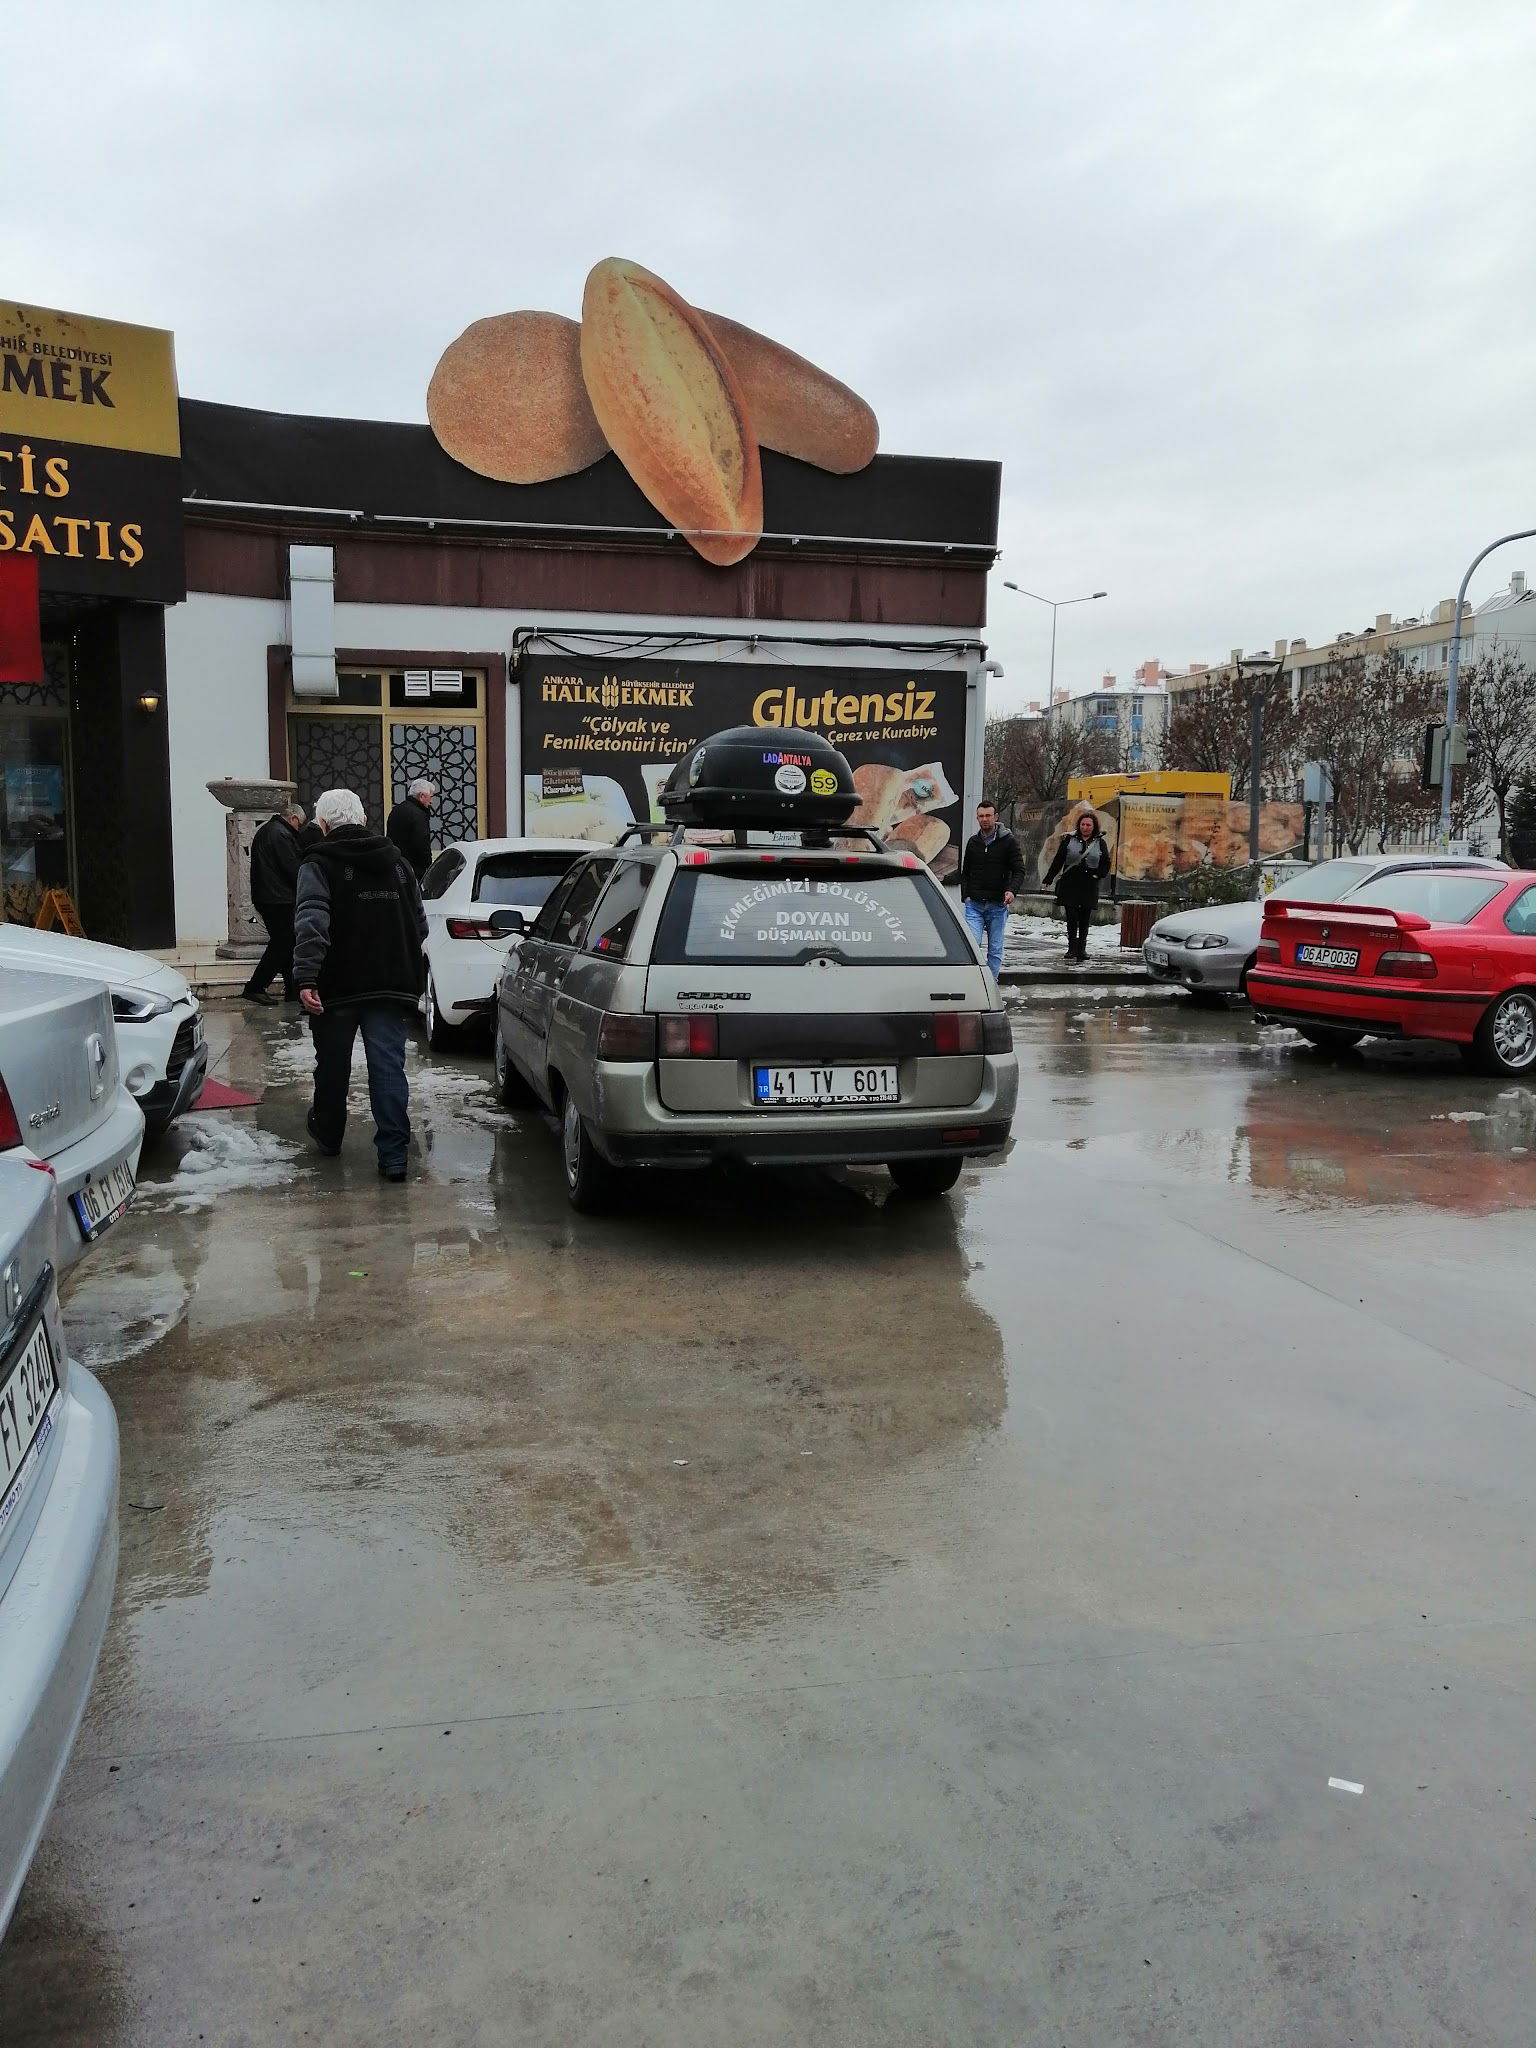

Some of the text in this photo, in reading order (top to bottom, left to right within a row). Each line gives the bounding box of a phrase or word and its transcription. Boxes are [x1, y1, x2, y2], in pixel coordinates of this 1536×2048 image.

[33, 342, 113, 367] BELEDİYESİ
[2, 353, 116, 408] MEK
[543, 675, 584, 686] ANKARA
[542, 684, 695, 707] HALK EKMEK
[752, 680, 936, 728] Glutensiz
[651, 721, 671, 734] ve
[828, 724, 938, 745] Çerez ve Kurabiye
[543, 734, 656, 752] Fenilketonüri
[813, 776, 836, 790] 59
[720, 877, 908, 943] EKMEĞİMİZİ BÖLÜŞTÜK
[776, 911, 850, 927] DOYAN
[757, 927, 873, 945] DÜŞMAN OLDU
[774, 1070, 888, 1094] 41 TV 601
[82, 1187, 101, 1223] 06
[99, 1174, 116, 1211] FY
[21, 1331, 51, 1427] 3240
